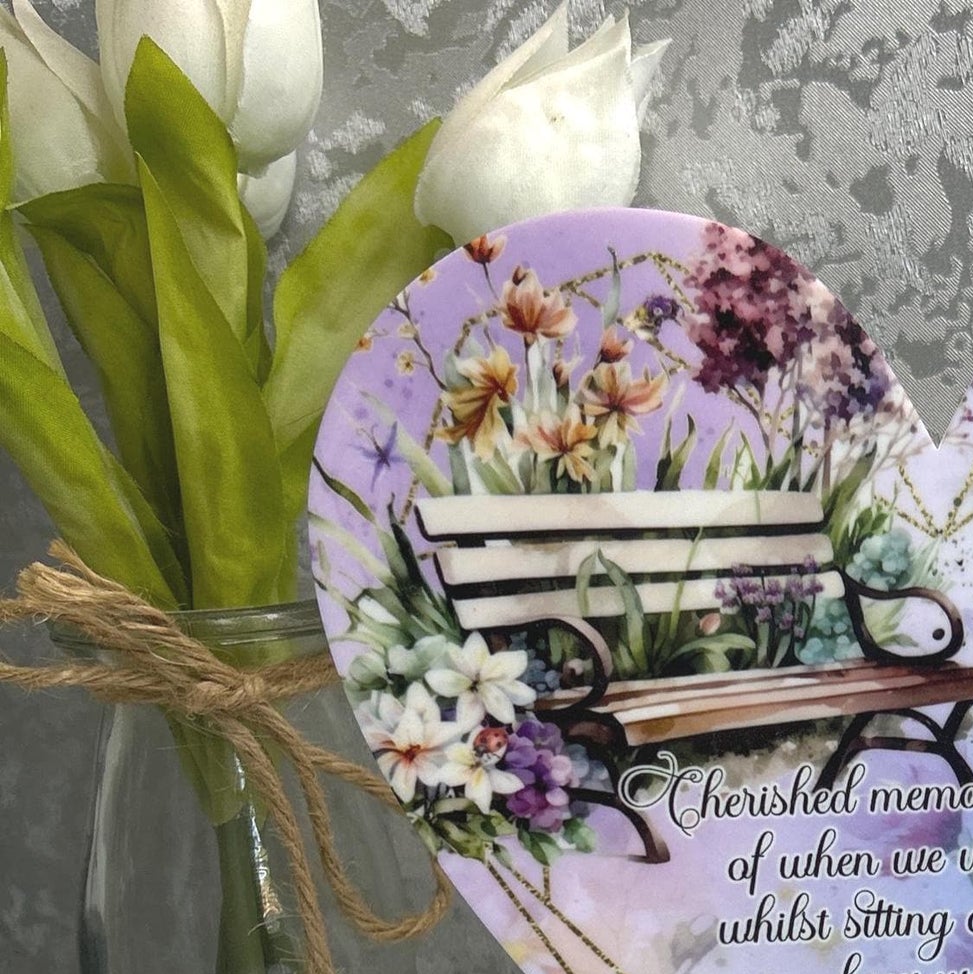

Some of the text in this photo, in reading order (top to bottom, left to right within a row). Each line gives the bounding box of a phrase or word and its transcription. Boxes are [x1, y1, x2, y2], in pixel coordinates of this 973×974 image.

[618, 750, 866, 838] Cherished
[727, 830, 774, 895] of
[779, 828, 879, 880] when
[893, 845, 945, 873] we
[718, 892, 831, 945] whilst
[843, 889, 953, 961] sitting
